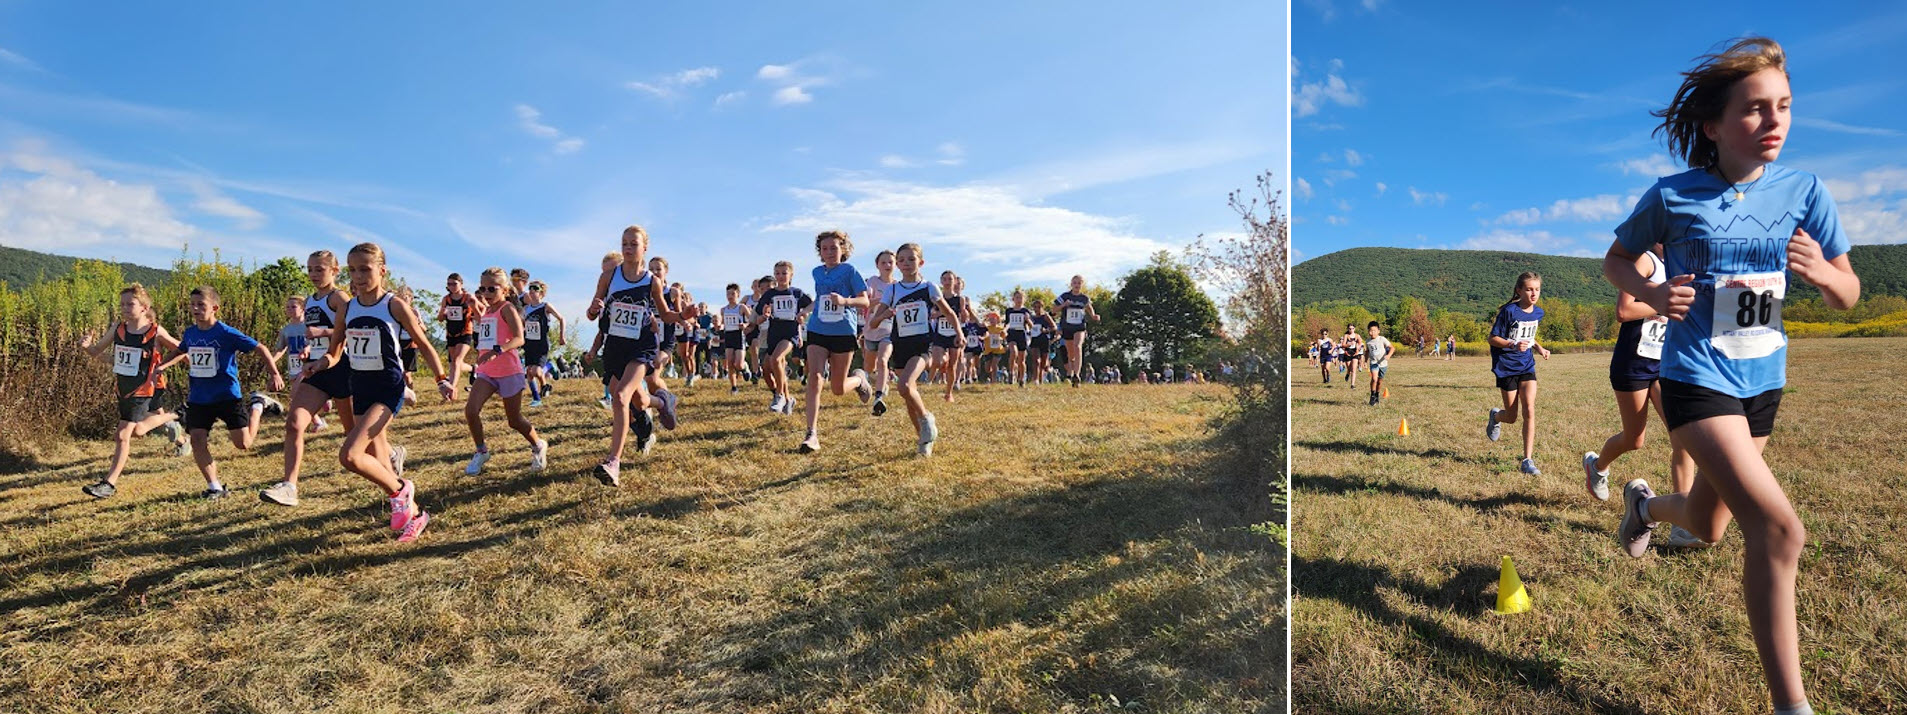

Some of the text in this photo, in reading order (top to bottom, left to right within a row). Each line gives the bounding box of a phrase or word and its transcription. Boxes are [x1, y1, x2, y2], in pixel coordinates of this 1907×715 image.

[1685, 237, 1789, 272] NITTAN
[774, 300, 793, 310] 110
[1736, 289, 1774, 327] 86
[615, 309, 638, 326] 235
[903, 308, 919, 323] 87
[1649, 322, 1668, 343] 42
[352, 336, 370, 355] 77
[119, 351, 131, 365] 91
[191, 353, 212, 366] 127
